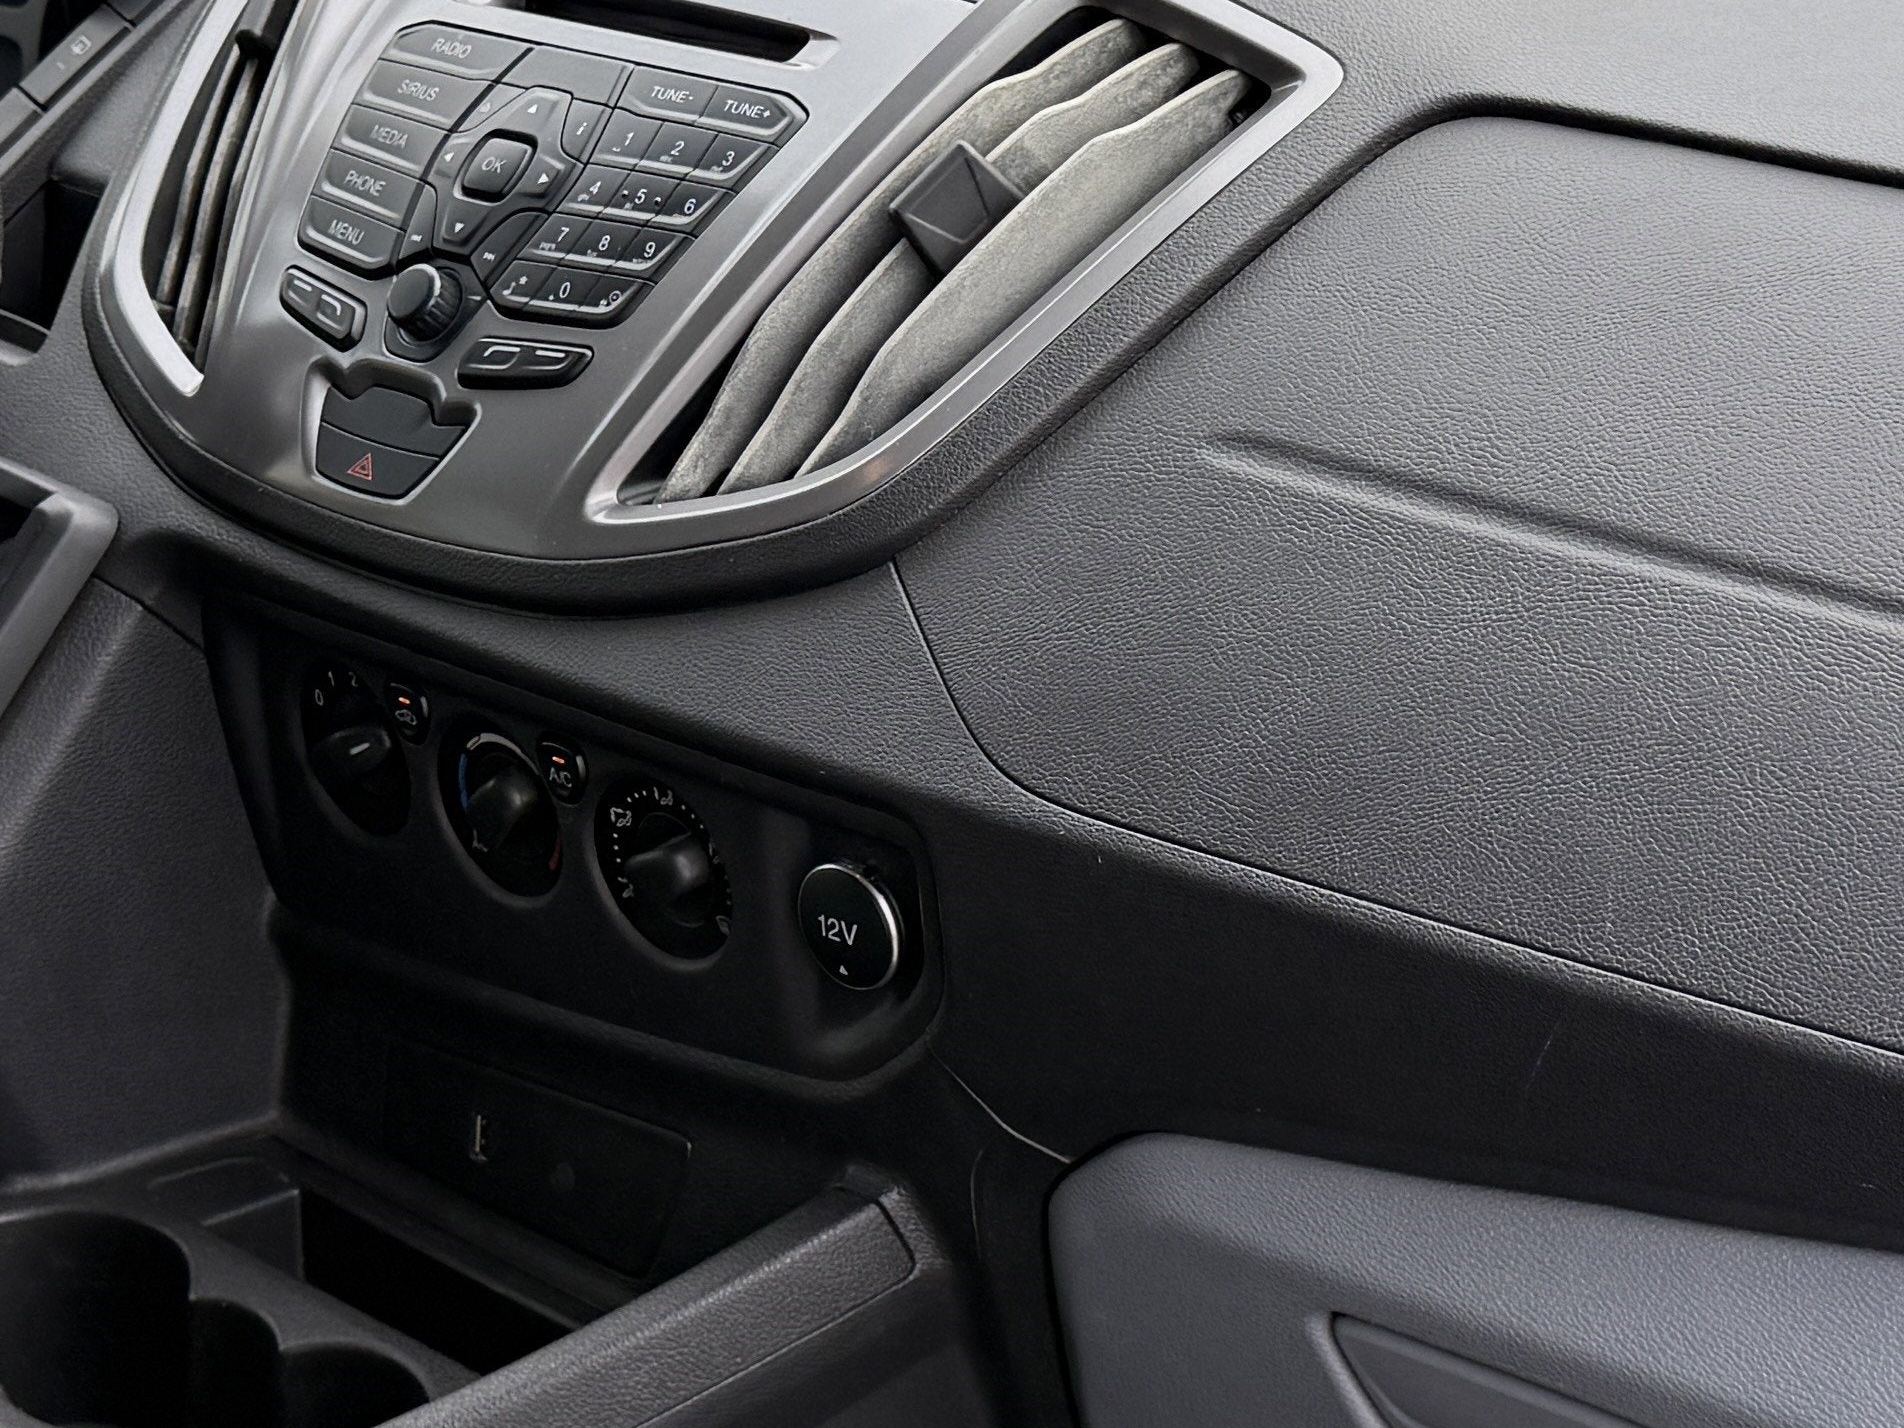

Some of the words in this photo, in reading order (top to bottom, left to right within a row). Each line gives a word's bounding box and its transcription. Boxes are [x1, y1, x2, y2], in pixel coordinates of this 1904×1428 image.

[429, 36, 473, 60] RADIO
[397, 78, 440, 103] SIRIUS
[368, 124, 410, 150] MEDIA
[623, 131, 636, 147] 1
[669, 139, 685, 157] 2
[721, 149, 736, 167] 3
[480, 157, 506, 175] OK
[343, 169, 387, 198] PHONE
[588, 180, 602, 196] 4
[634, 188, 648, 206] 5
[683, 197, 697, 215] 6
[327, 218, 366, 246] MENU
[556, 226, 571, 243] 7
[597, 234, 612, 252] 8
[642, 241, 657, 259] 9
[558, 280, 572, 299] 0
[314, 687, 325, 707] 0
[348, 670, 359, 688] 2
[547, 766, 574, 789] A/C
[817, 914, 858, 946] 12V
